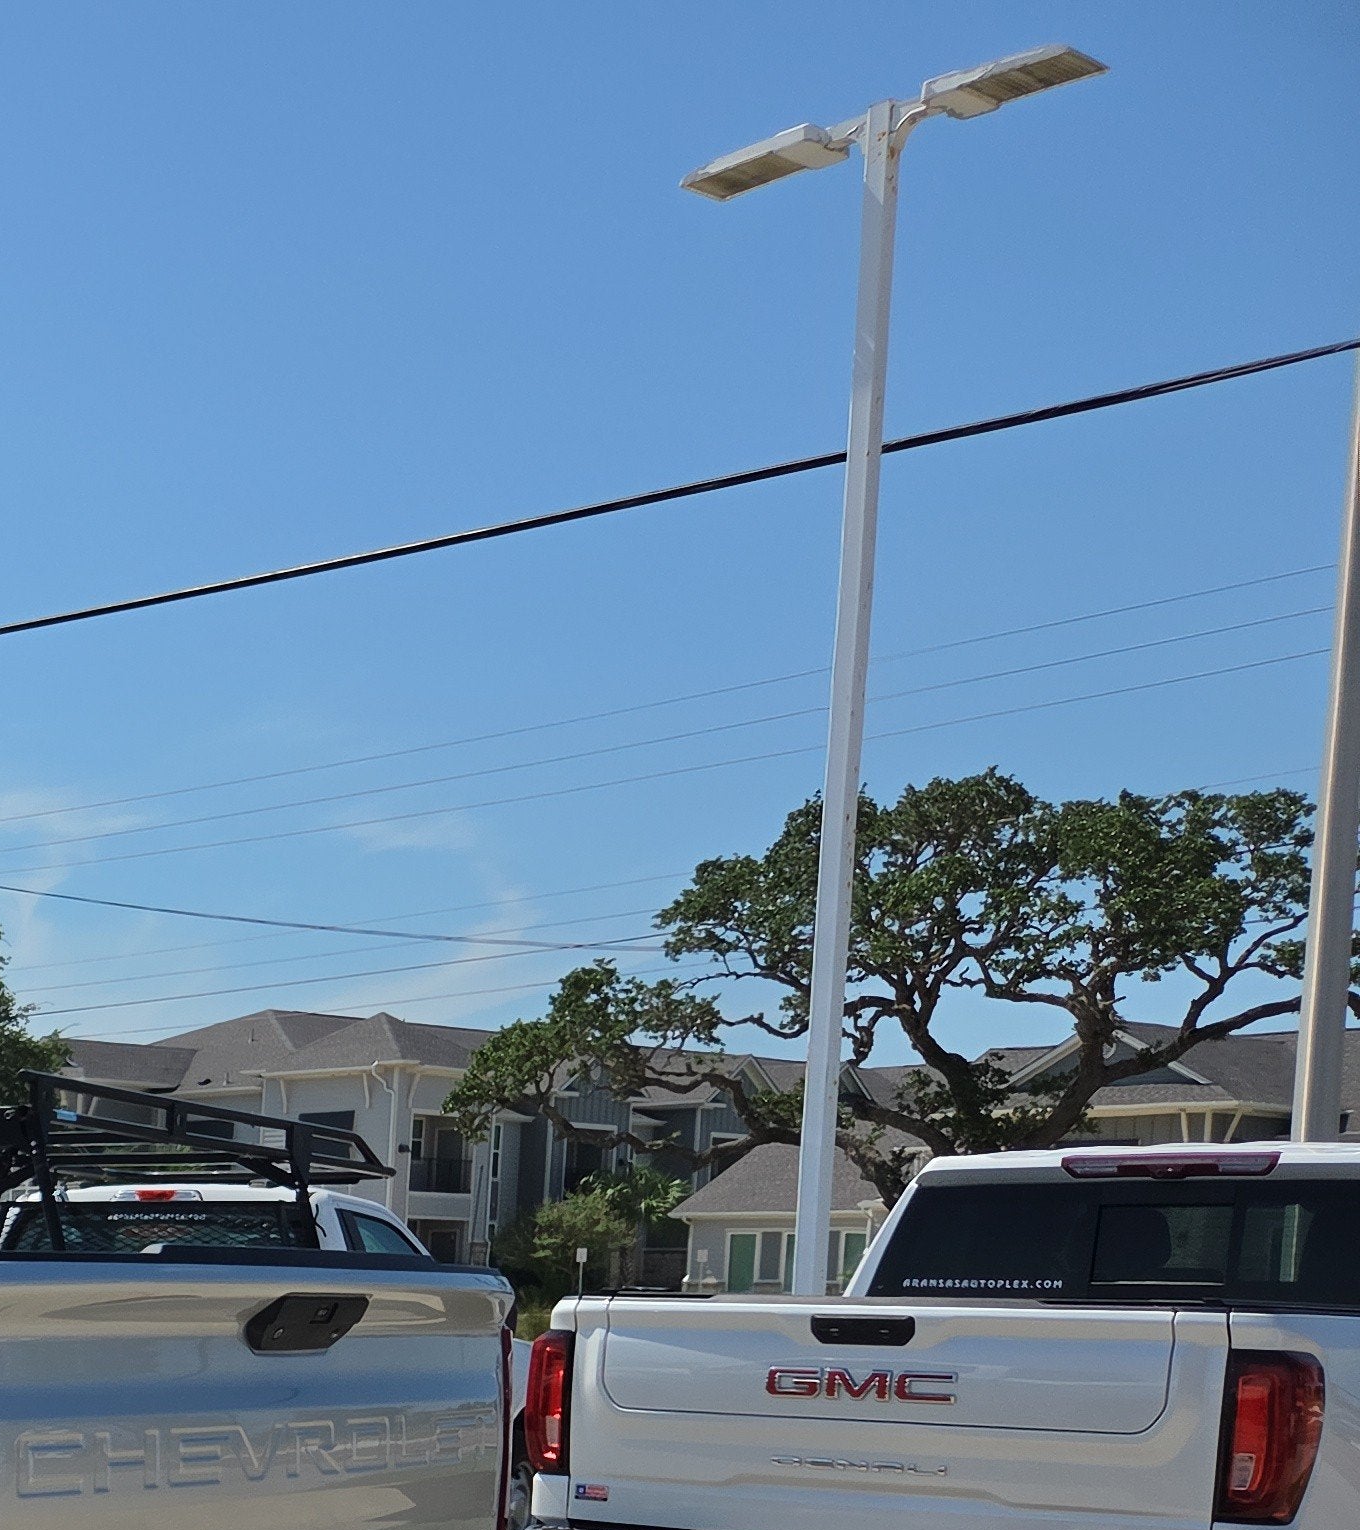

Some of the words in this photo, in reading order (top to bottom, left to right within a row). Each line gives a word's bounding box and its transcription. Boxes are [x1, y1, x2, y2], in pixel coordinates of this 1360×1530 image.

[902, 1278, 1064, 1290] ARANSASAUTOPLEX.COM
[764, 1365, 959, 1405] GMC
[16, 1408, 496, 1499] CHEVROLET
